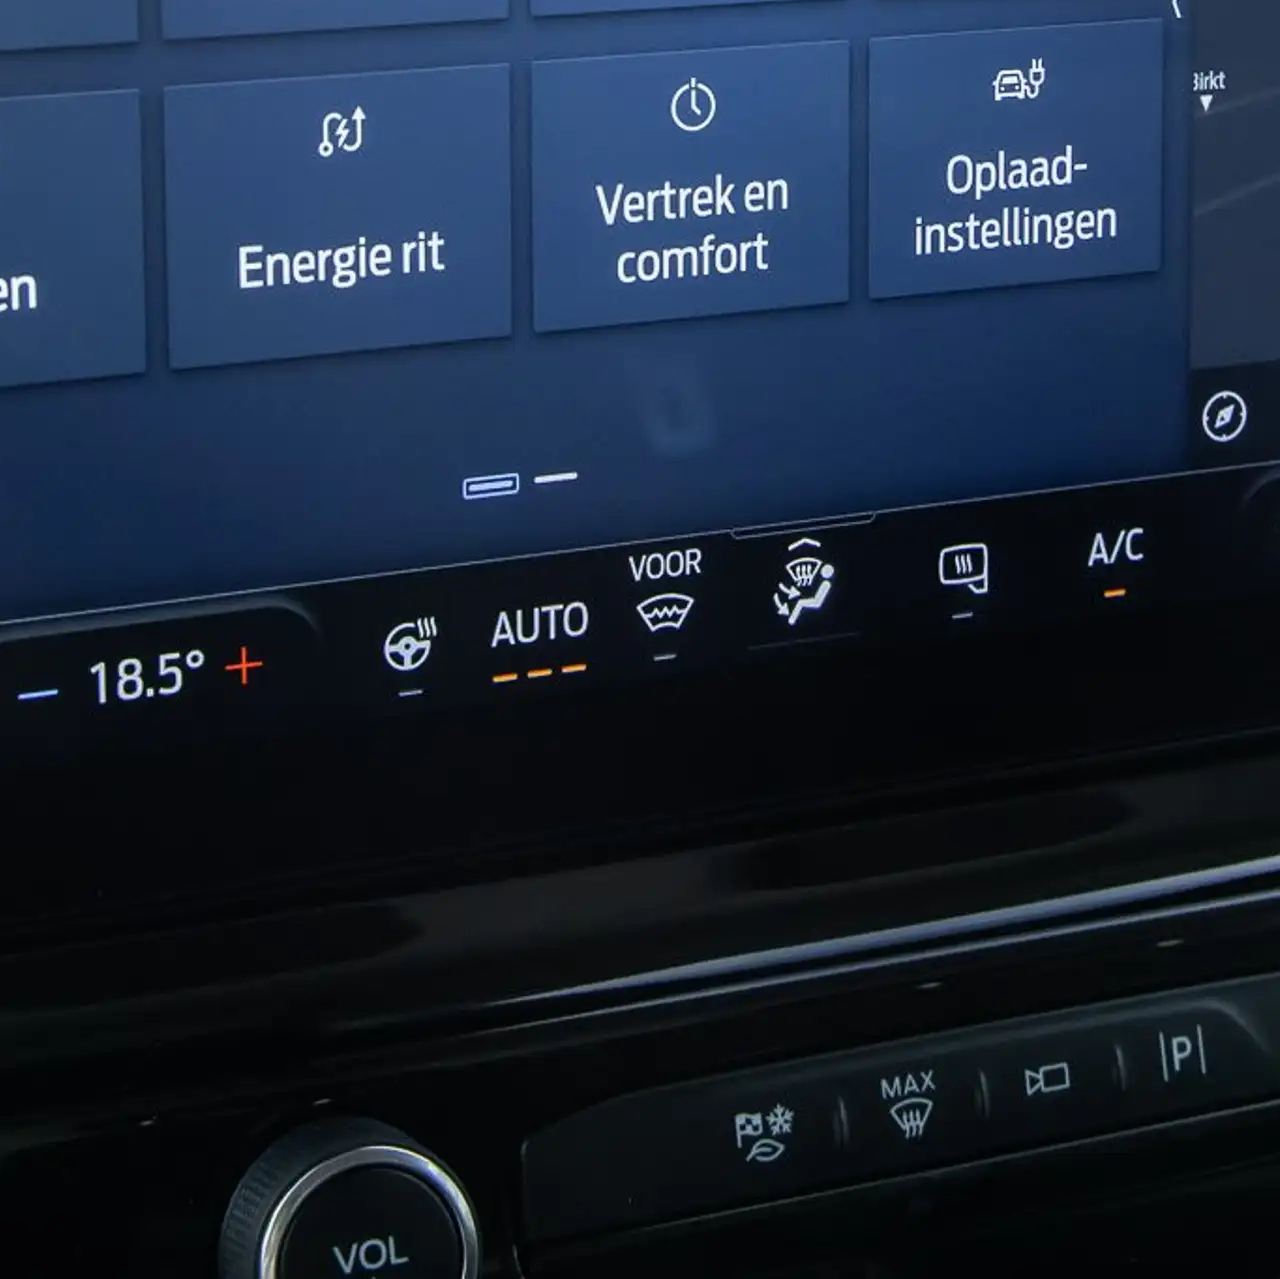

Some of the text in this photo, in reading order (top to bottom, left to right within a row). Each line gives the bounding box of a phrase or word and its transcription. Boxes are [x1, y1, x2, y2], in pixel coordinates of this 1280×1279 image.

[946, 144, 1088, 201] Oplaad-
[595, 173, 788, 226] Vertrek en
[915, 205, 1117, 256] instellingen
[238, 231, 445, 289] Energie rit
[617, 232, 769, 284] comfort
[628, 549, 702, 582] VOOR
[1087, 527, 1144, 567] A/C
[491, 601, 589, 648] AUTO
[90, 649, 205, 704] 18.5°
[880, 1069, 937, 1100] MAX
[333, 1235, 409, 1274] VOL
